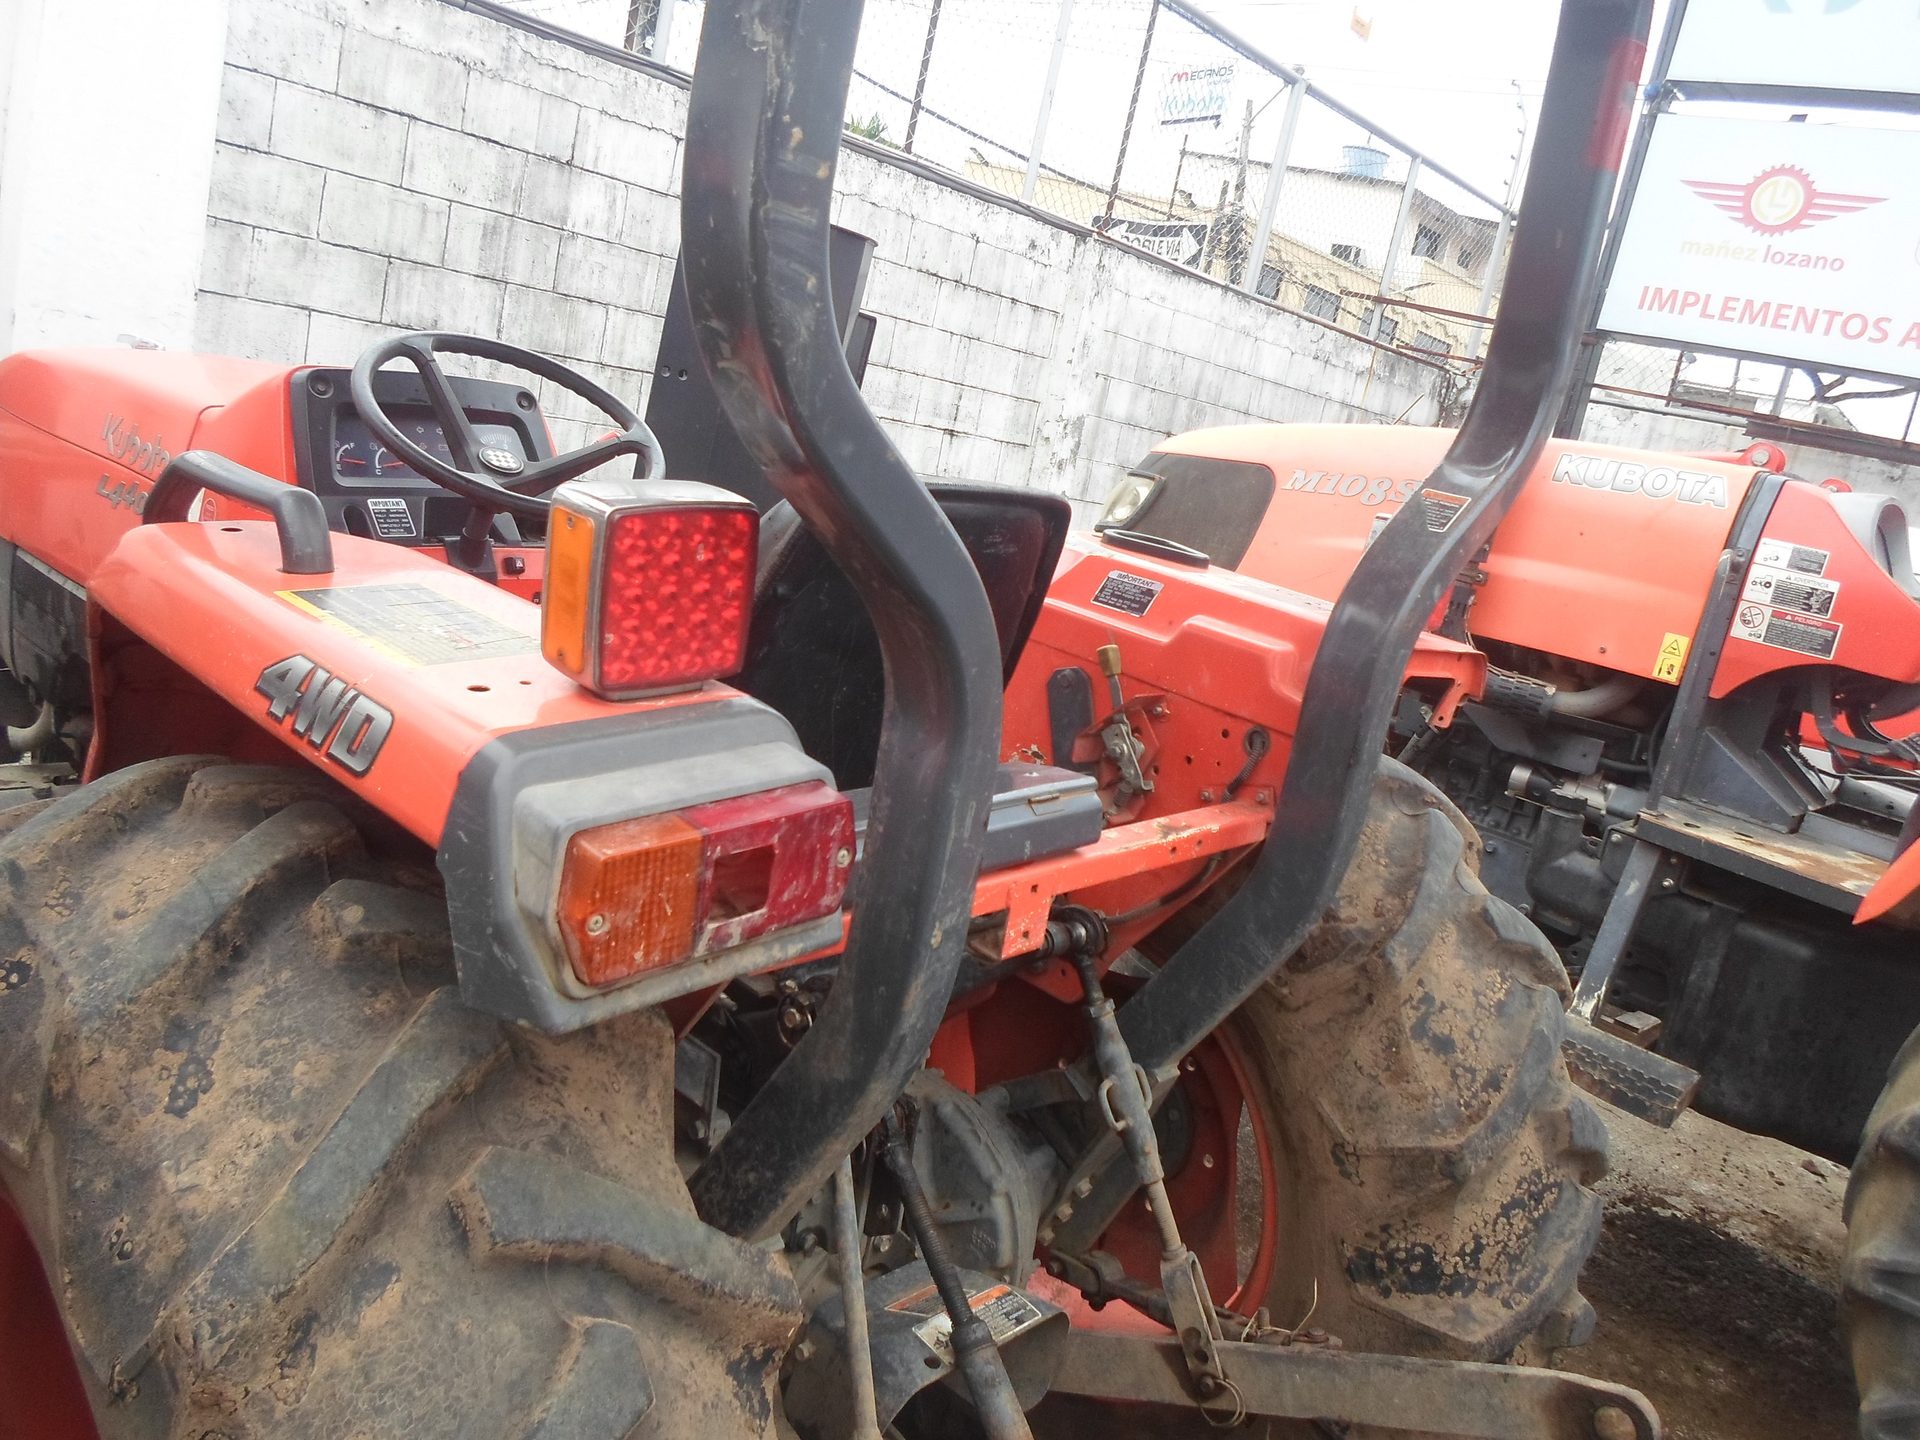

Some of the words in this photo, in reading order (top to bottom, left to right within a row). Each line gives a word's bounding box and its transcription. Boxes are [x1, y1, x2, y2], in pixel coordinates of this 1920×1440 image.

[1680, 239, 1759, 262] mañez
[1763, 244, 1845, 272] lozano
[1637, 285, 1892, 344] IMPLEMENTOS
[102, 412, 170, 475] Kubota
[1281, 468, 1424, 506] M108S
[1551, 453, 1727, 508] KUBOTA
[370, 500, 403, 508] IMPORTANT
[1116, 572, 1154, 588] IMPORTANT
[254, 653, 394, 778] 4WD
